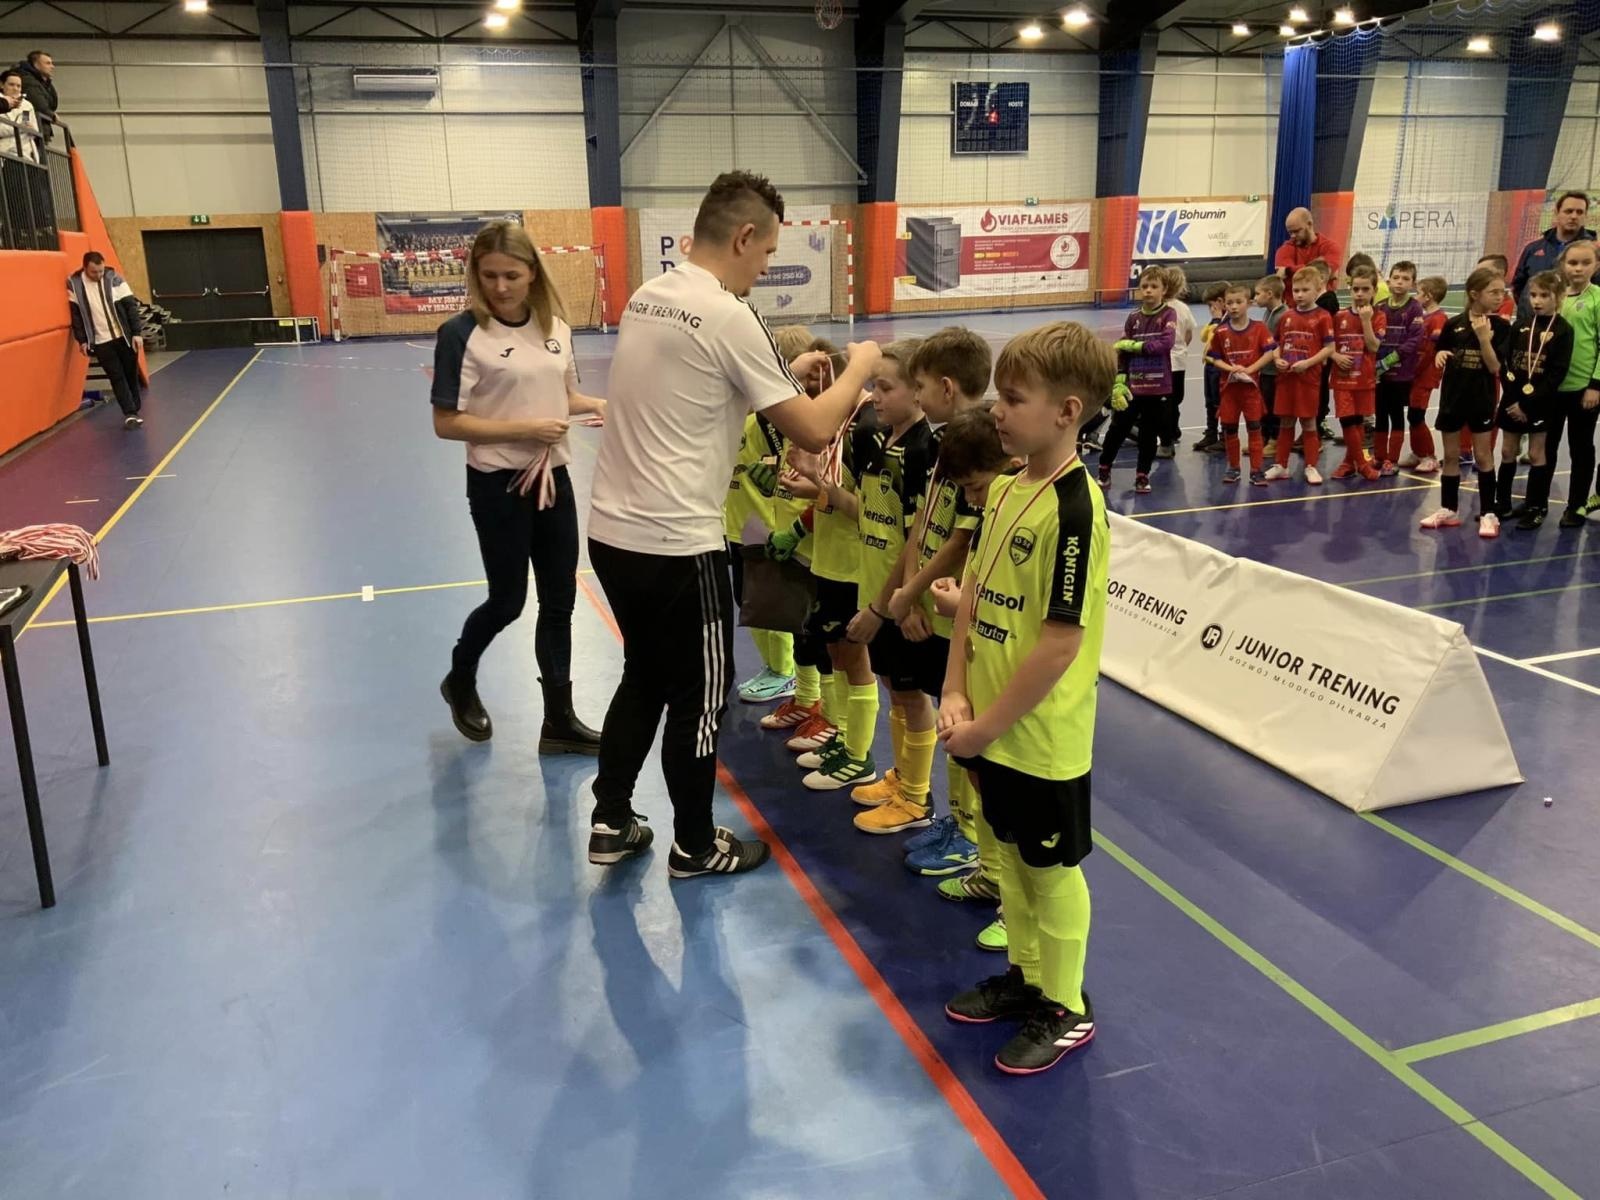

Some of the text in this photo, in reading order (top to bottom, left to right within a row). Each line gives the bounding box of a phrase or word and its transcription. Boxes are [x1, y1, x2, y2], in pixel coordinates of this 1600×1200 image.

[998, 212, 1069, 226] VIAFLAMES
[650, 305, 702, 329] TRENING
[1128, 588, 1188, 625] TRENING
[1235, 635, 1401, 715] JUNIOR TRENING
